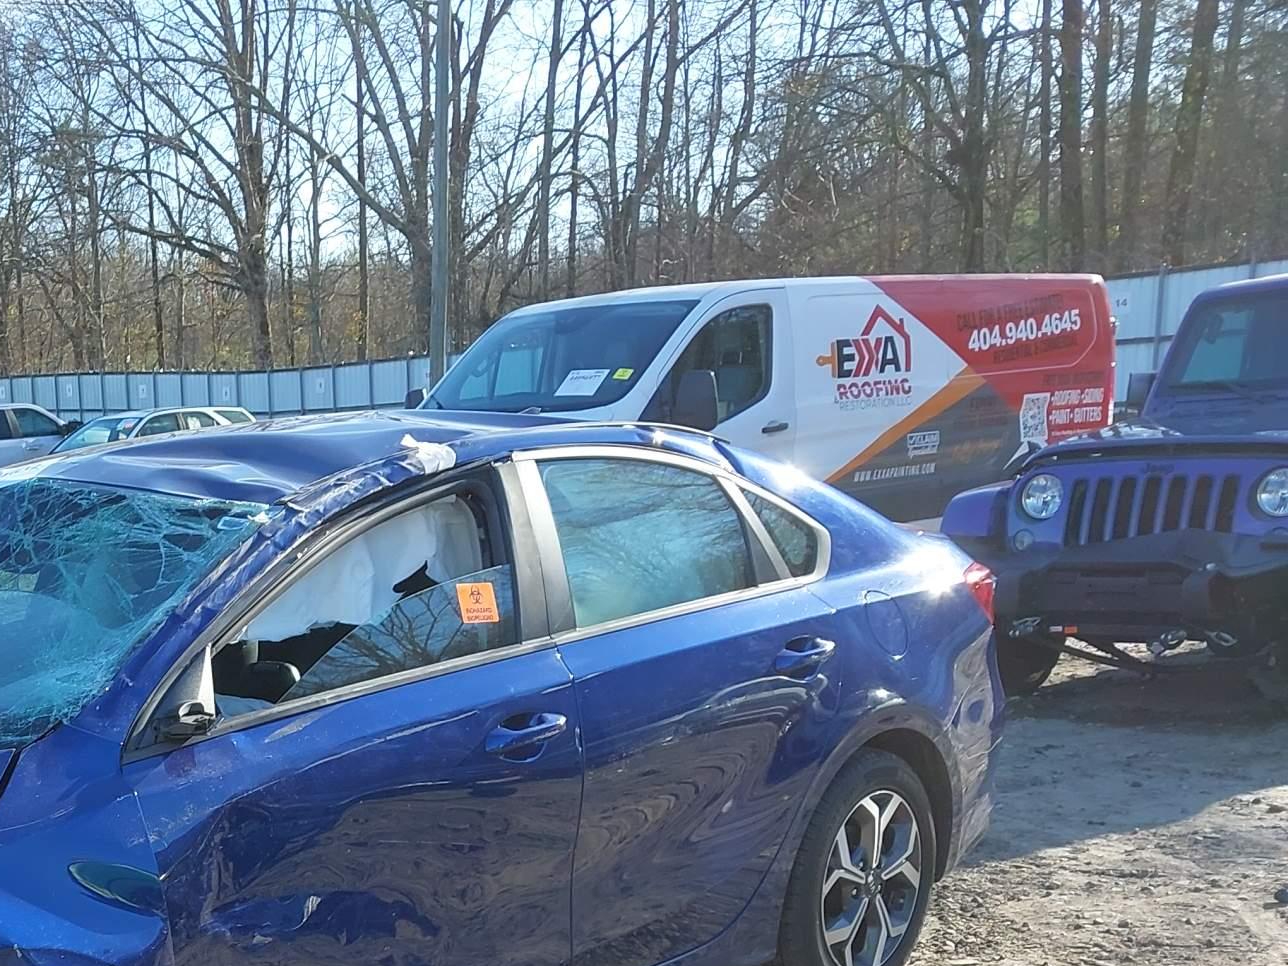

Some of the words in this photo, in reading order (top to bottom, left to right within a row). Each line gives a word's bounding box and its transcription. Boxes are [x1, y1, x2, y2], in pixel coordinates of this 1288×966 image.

[1116, 298, 1128, 308] 14
[968, 308, 1081, 352] 404.940.4645
[837, 378, 912, 400] ROOFING
